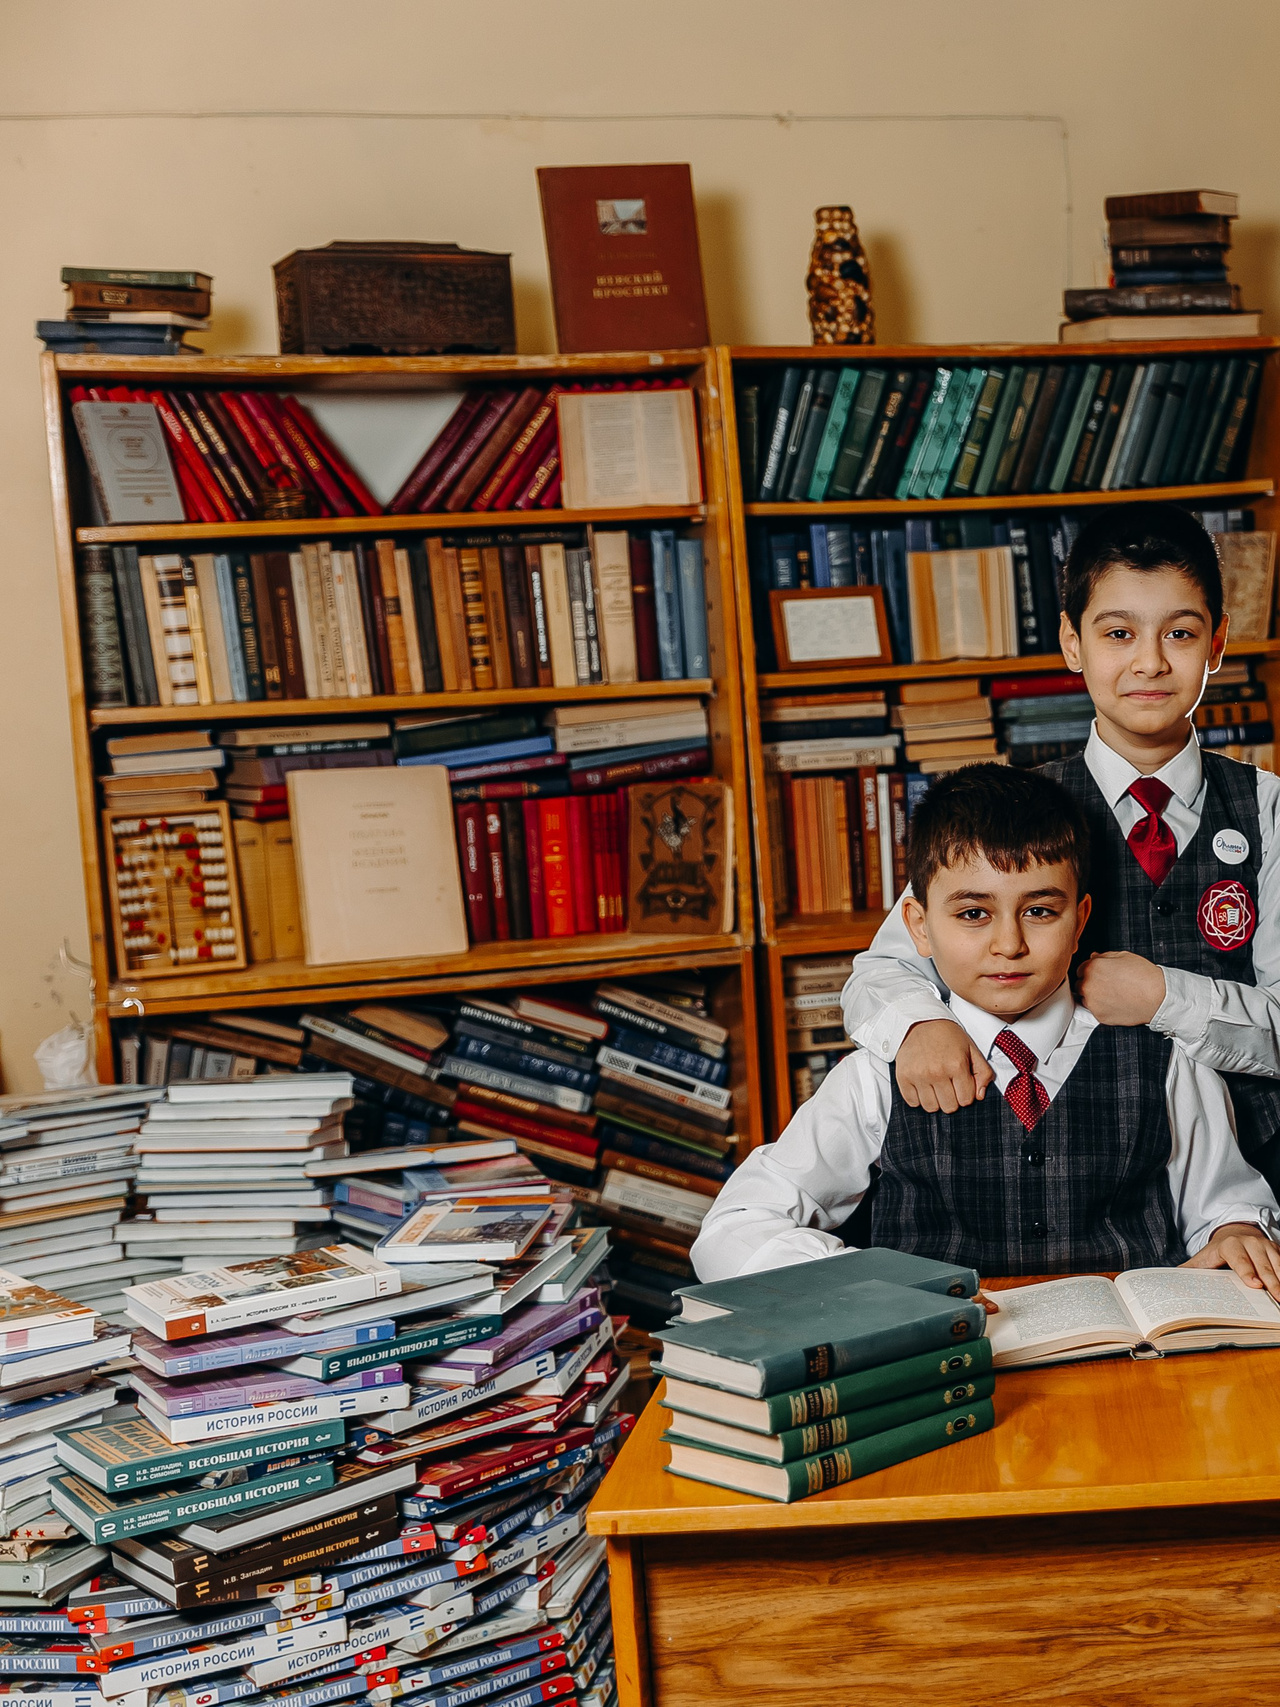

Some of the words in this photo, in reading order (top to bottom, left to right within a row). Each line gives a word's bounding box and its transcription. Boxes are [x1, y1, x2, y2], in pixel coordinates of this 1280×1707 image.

[1218, 911, 1228, 923] 58
[379, 1280, 389, 1293] 11
[389, 1336, 439, 1359] ВСЕОБЩАЯ
[177, 1359, 191, 1373] 11
[346, 1349, 388, 1368] ИСТОРИЯ
[536, 1358, 547, 1375] 11
[329, 1360, 341, 1375] 10
[418, 1394, 458, 1418] ИСТОРИЯ
[461, 1380, 497, 1401] РОССИИ
[955, 1388, 964, 1397] 2
[180, 1401, 194, 1414] 11
[340, 1397, 356, 1413] 11
[206, 1413, 264, 1432] ИСТОРИЯ
[268, 1405, 318, 1423] РОССИИ
[188, 1447, 253, 1470] ВСЕОБЩАЯ
[255, 1437, 309, 1456] ИСТОРИЯ
[150, 1462, 184, 1474] ЗАГЛАДИН,
[266, 1456, 301, 1473] Алгебра
[480, 1465, 506, 1481] Алгебра
[114, 1473, 130, 1488] 10
[149, 1468, 181, 1480] СИМОНИЯ
[176, 1493, 242, 1517] ВСЕОБЩАЯ
[245, 1478, 300, 1500] ИСТОРИЯ
[137, 1510, 172, 1522] ЗАГЛАДИН,
[137, 1516, 169, 1529] СИМОНИЯ
[324, 1511, 358, 1529] ИСТОРИЯ
[102, 1522, 117, 1538] 10
[537, 1535, 548, 1550] 11
[193, 1554, 209, 1574] 11
[223, 1575, 239, 1585] Н.В.
[240, 1564, 273, 1580] Загладин
[283, 1547, 324, 1567] ВСЕОБЩАЯ
[325, 1535, 360, 1555] ИСТОРИЯ
[492, 1547, 525, 1570] РОССИИ
[195, 1580, 210, 1599] 11
[398, 1569, 442, 1594] РОССИИ
[500, 1577, 530, 1603] РОССИИ
[20, 1619, 65, 1632] РОССИИ
[206, 1612, 265, 1635] ИСТОРИЯ
[409, 1614, 425, 1631] 11
[152, 1626, 204, 1649] РОССИИ
[277, 1635, 294, 1652] 11
[287, 1644, 341, 1671] ИСТОРИЯ
[344, 1627, 390, 1651] РОССИИ
[12, 1658, 60, 1670] РОССИИ
[141, 1658, 200, 1683] ИСТОРИЯ
[203, 1646, 255, 1668] РОССИИ
[442, 1658, 479, 1679] ИСТОРИЯ
[480, 1649, 512, 1668] РОССИИ
[411, 1678, 424, 1688] 7
[447, 1682, 491, 1707] ИСТОРИЯ
[493, 1667, 530, 1691] РОССИИ
[196, 1694, 212, 1705] 6
[305, 1683, 350, 1705] РОССИИ
